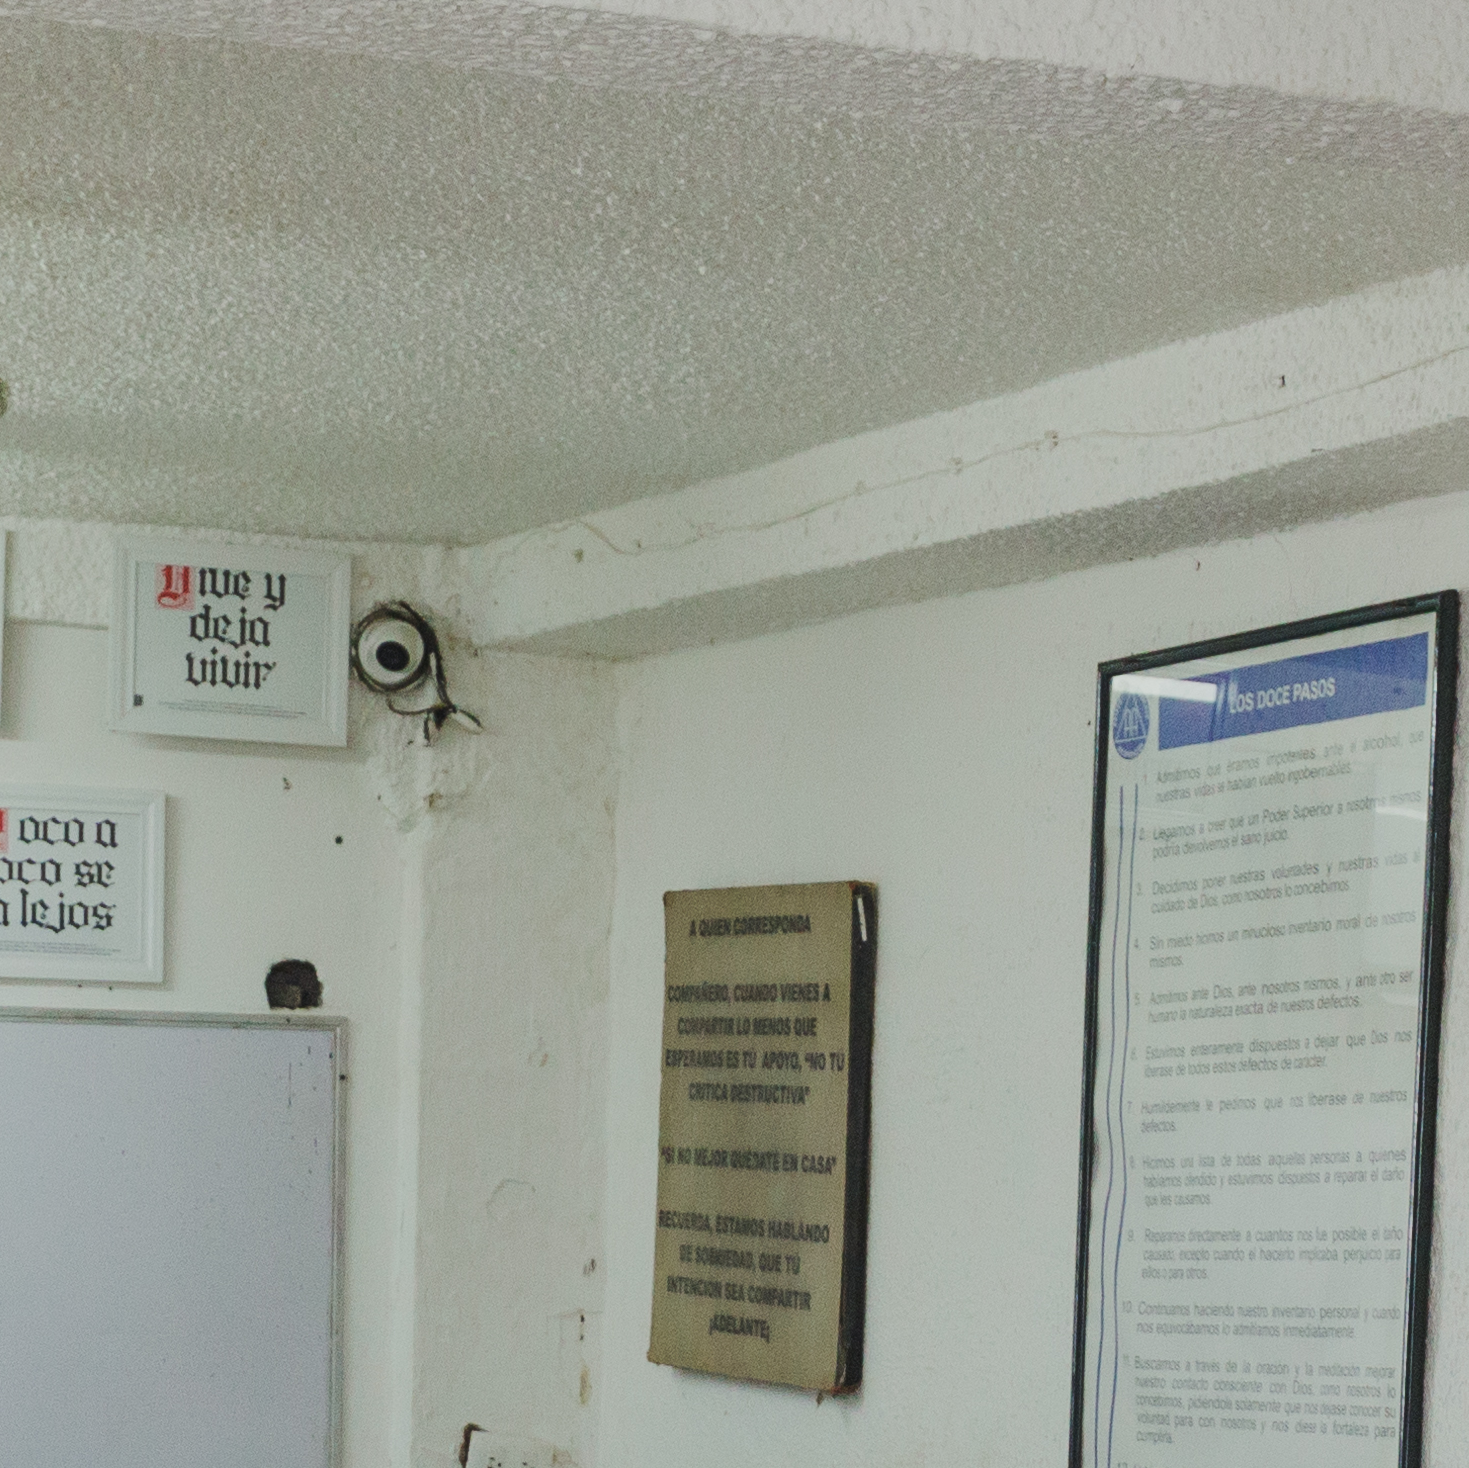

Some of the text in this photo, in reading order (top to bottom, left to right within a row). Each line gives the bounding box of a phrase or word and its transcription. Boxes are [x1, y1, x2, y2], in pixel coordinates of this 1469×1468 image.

[157, 564, 287, 612] Vive y
[189, 603, 271, 649] deja
[185, 647, 277, 690] vivir
[1258, 685, 1291, 709] DOCE
[1293, 677, 1335, 702] PASOS
[1262, 807, 1289, 827] Poder
[1292, 801, 1333, 822] Superior
[95, 818, 118, 848] a
[74, 860, 115, 887] se
[20, 888, 117, 933] lejos
[689, 912, 811, 938] A QUIEN CORRESPONDA
[734, 982, 776, 1002] CUANDO
[822, 981, 831, 1000] A
[677, 1016, 816, 1035] COMPARTIR LO MENOS QUE
[665, 1049, 722, 1068] ESPERAMOS
[726, 1050, 739, 1068] ES
[782, 1153, 797, 1171] EN
[715, 1215, 764, 1237] ESTAMOS
[679, 1244, 691, 1263] DE
[759, 1252, 781, 1272] QUE
[724, 1282, 744, 1302] SEA
[747, 1284, 811, 1310] COMPARTIR
